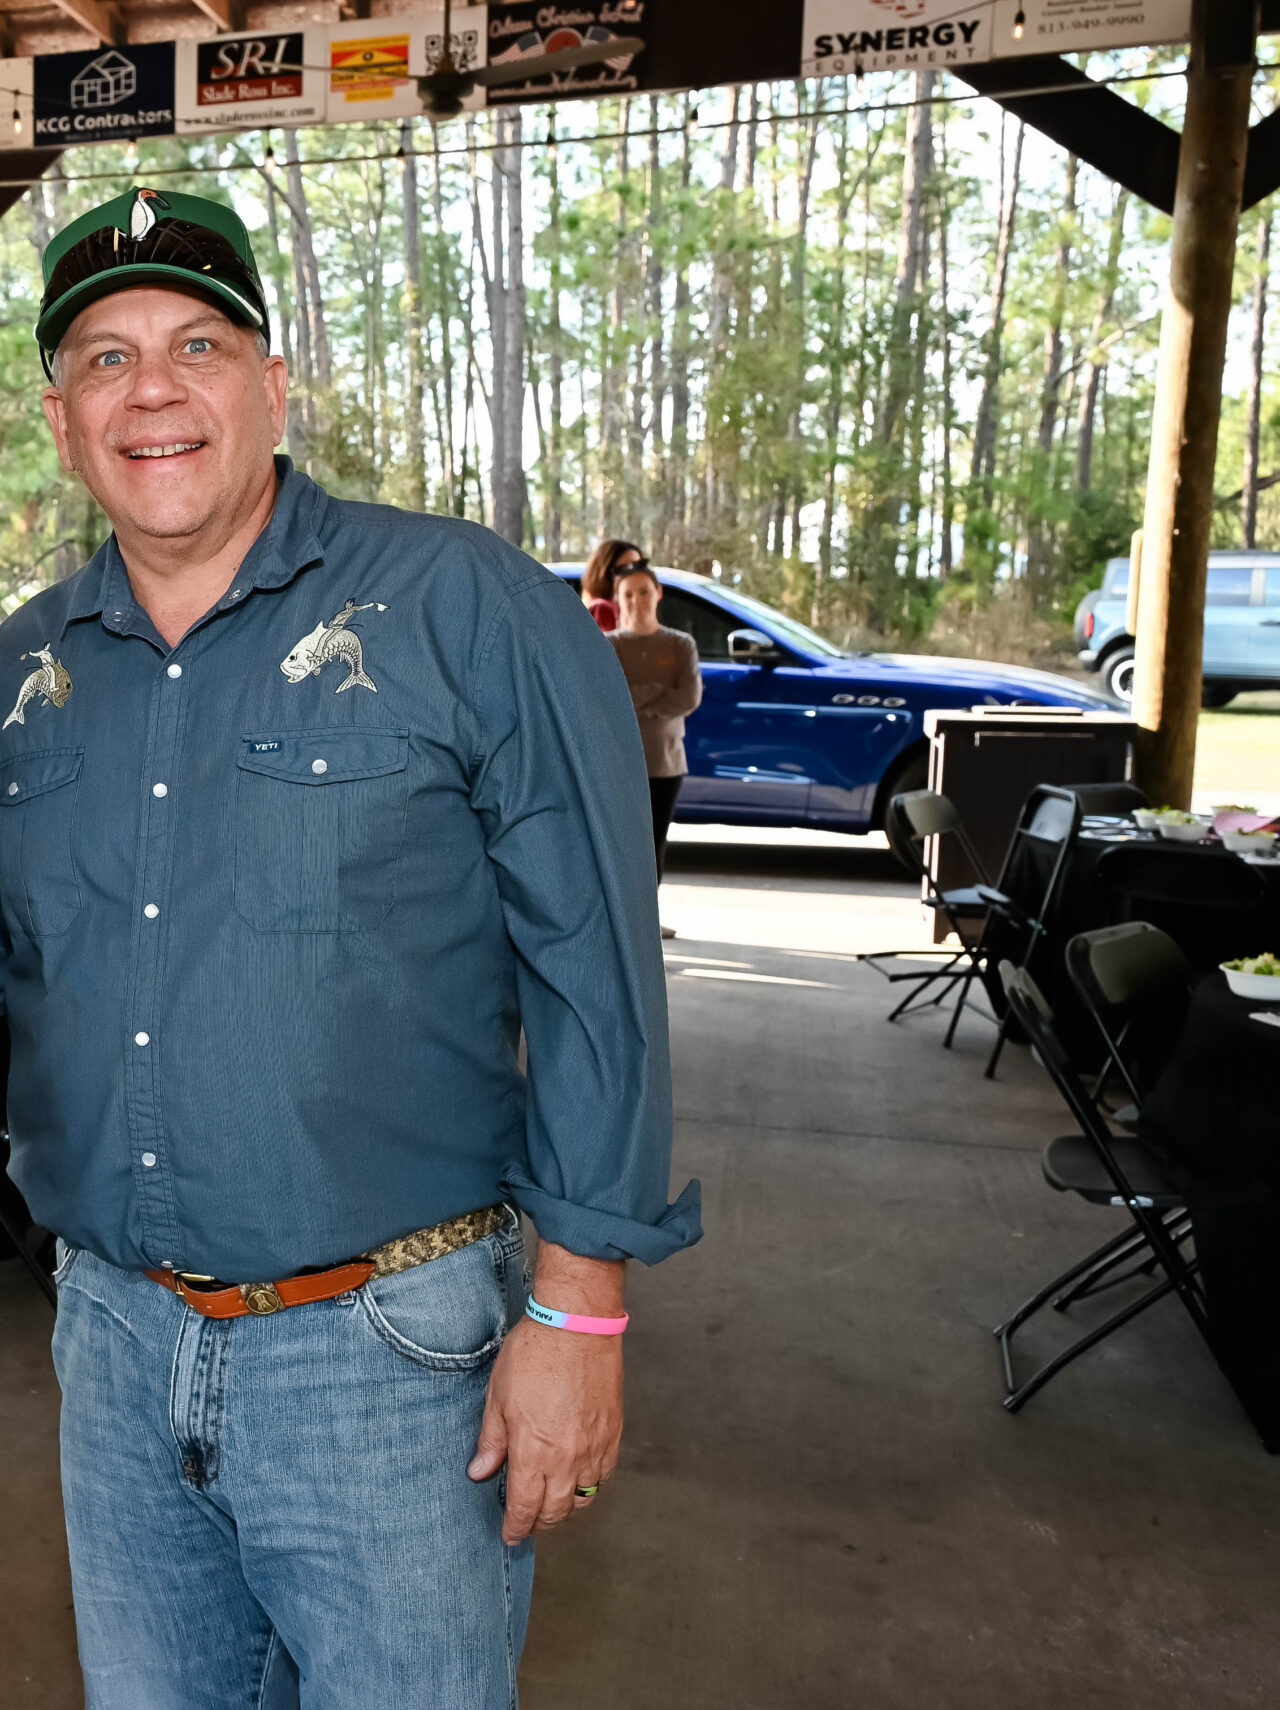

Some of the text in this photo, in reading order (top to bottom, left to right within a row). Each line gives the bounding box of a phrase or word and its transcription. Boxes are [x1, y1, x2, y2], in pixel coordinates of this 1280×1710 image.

[813, 19, 981, 59] SYNERGY
[210, 37, 289, 80] SRI
[816, 46, 976, 73] EQUIPMENT
[35, 115, 72, 134] KCG
[254, 741, 279, 751] YETI
[533, 1310, 553, 1322] FARA
